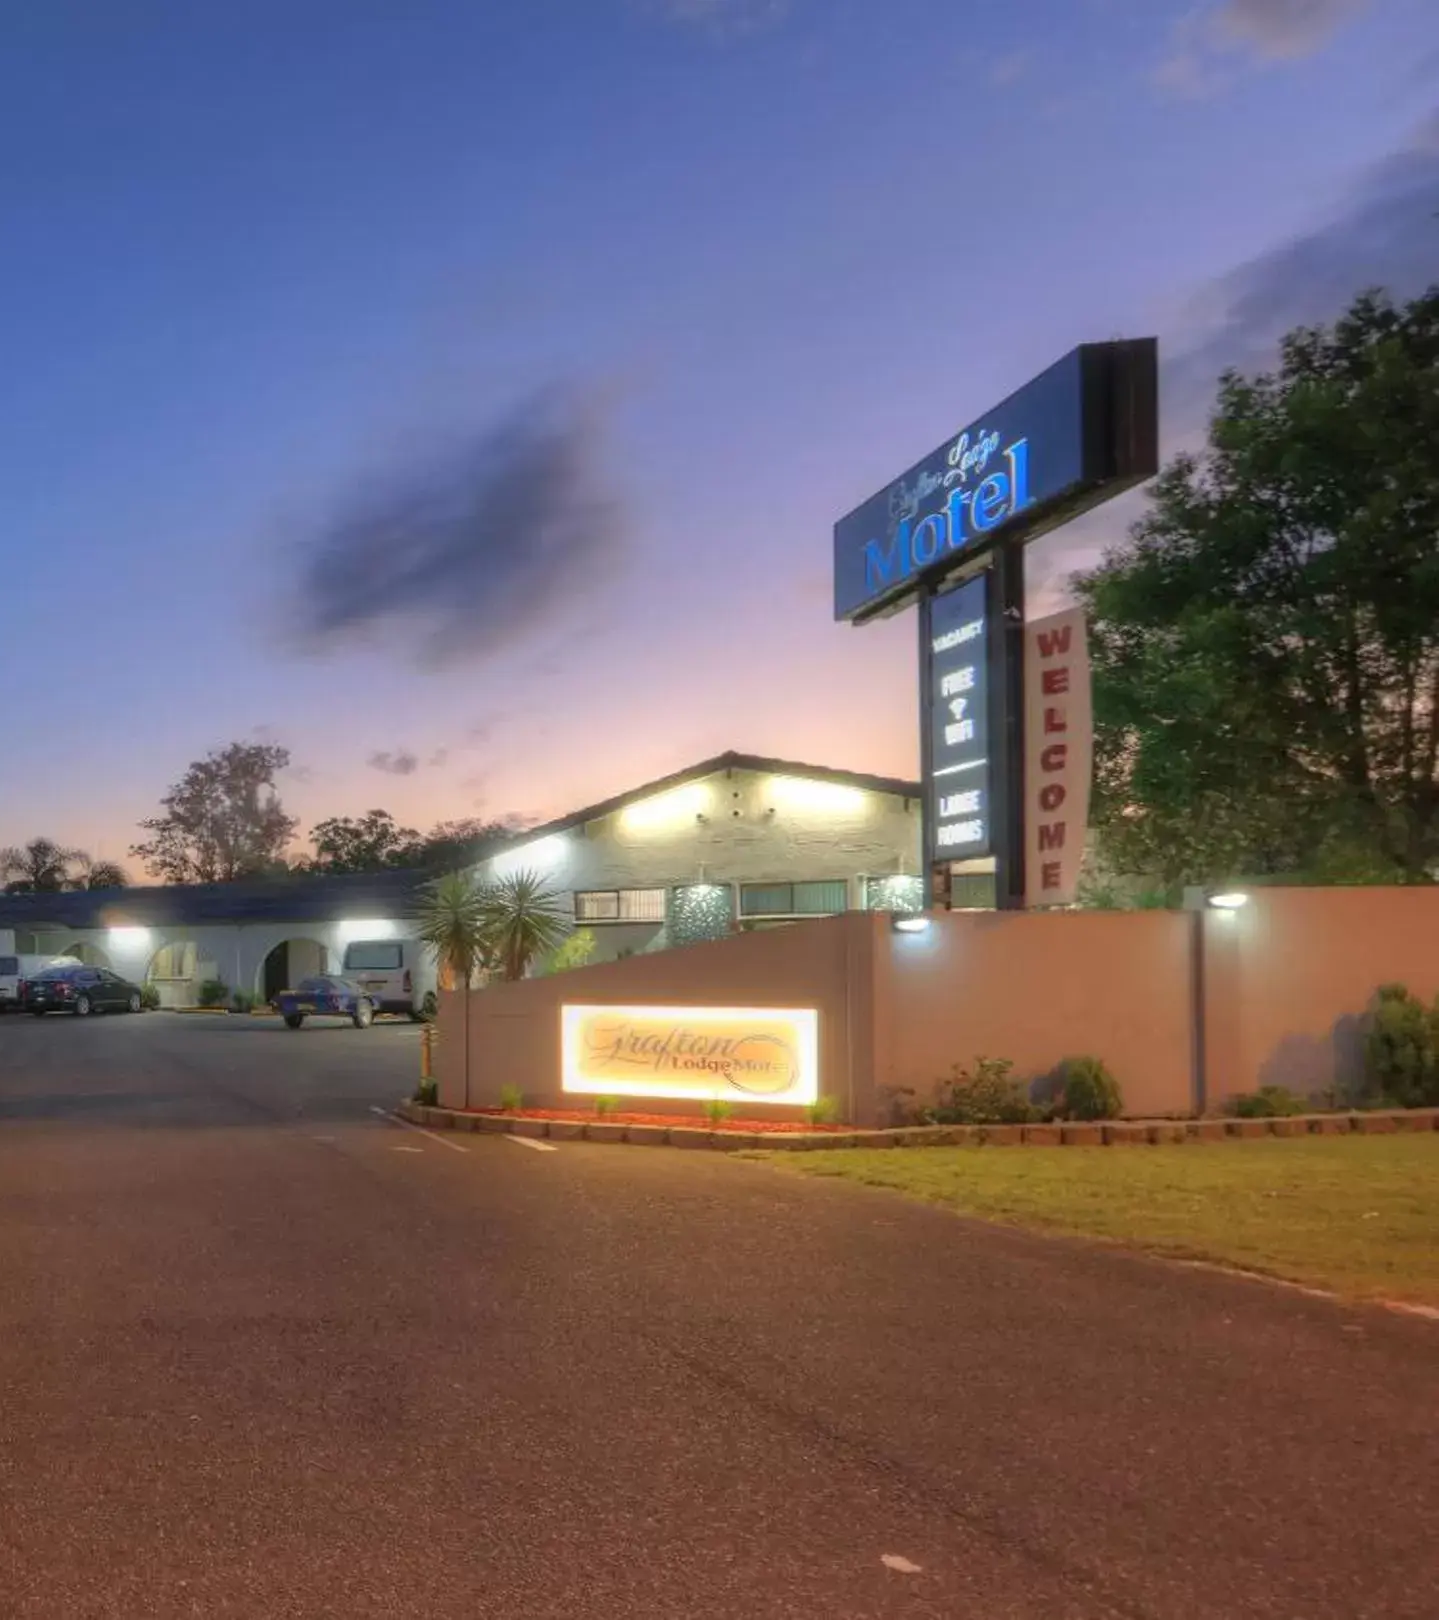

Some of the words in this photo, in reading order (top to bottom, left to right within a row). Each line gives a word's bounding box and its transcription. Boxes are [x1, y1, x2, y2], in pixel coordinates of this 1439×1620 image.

[864, 437, 1036, 593] Motel
[941, 666, 976, 698] FREE
[1037, 625, 1072, 890] WELCOME
[585, 1022, 738, 1071] Grafton
[671, 1056, 731, 1073] Lodge
